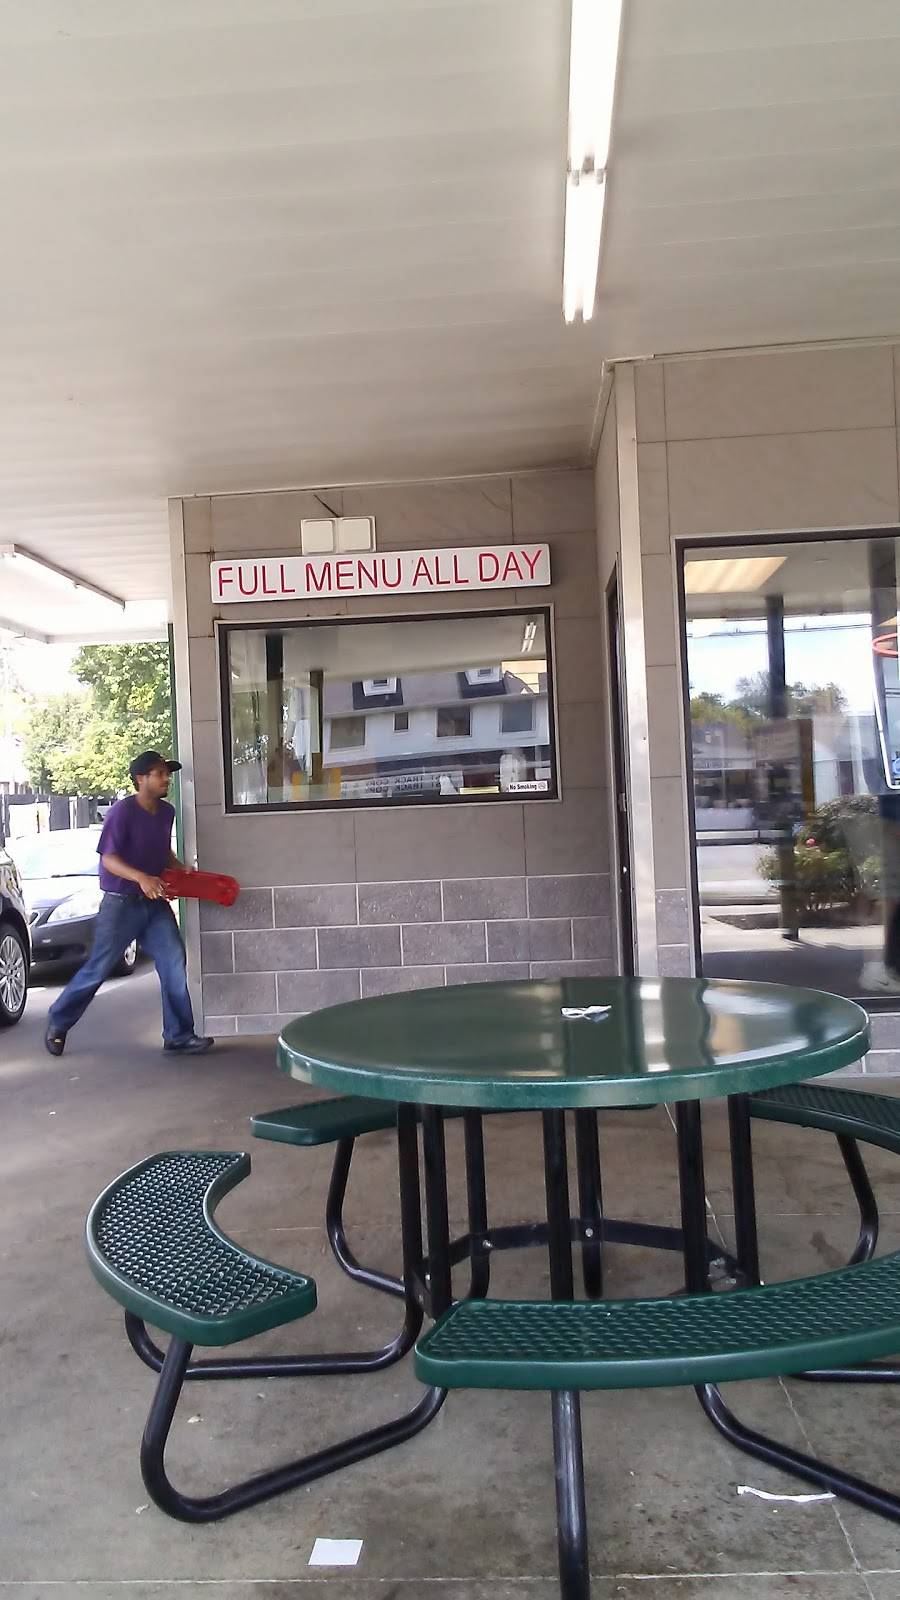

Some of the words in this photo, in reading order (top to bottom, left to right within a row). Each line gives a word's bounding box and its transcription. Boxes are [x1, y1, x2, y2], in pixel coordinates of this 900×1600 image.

[218, 564, 295, 596] FULL
[305, 558, 401, 592] MENU
[412, 554, 469, 586] ALL
[478, 549, 543, 582] DAY
[516, 783, 538, 791] Smoking
